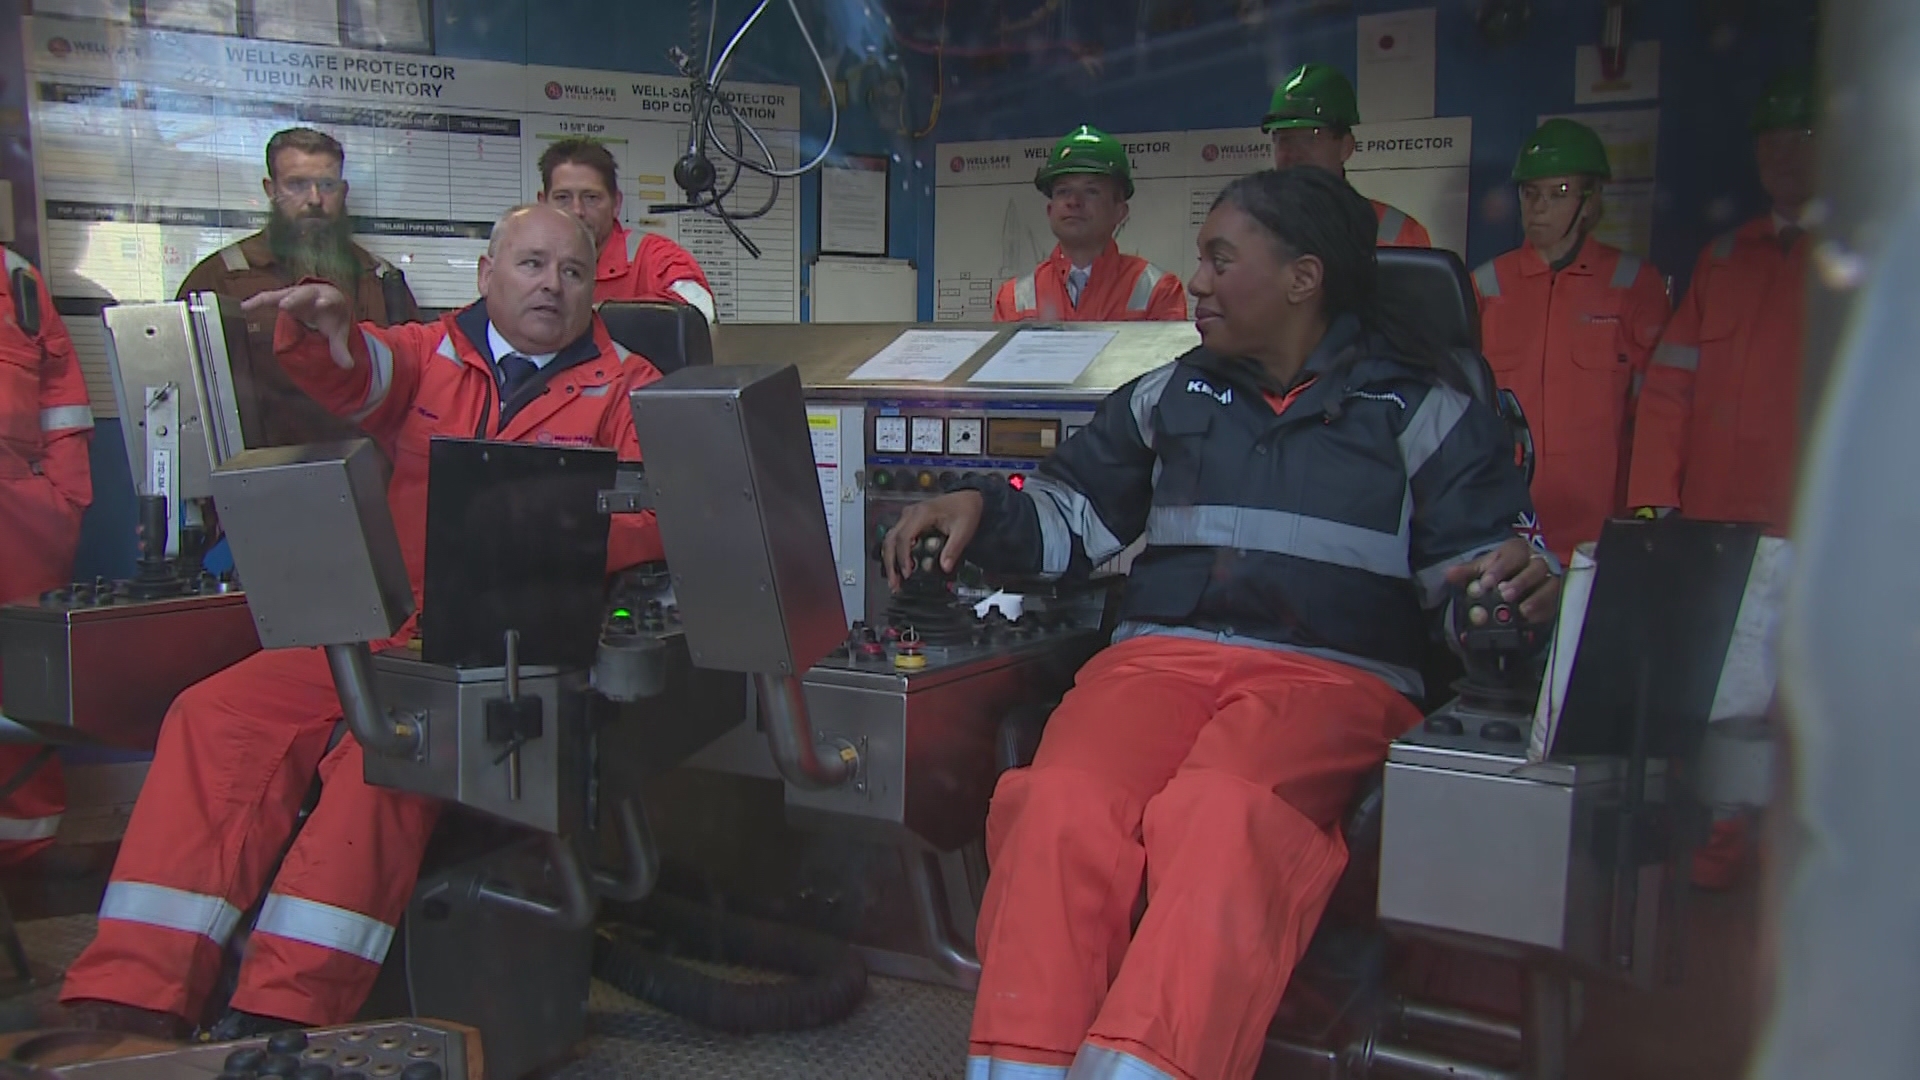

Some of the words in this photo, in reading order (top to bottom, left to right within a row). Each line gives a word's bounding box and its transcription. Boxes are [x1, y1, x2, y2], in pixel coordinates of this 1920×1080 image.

[226, 47, 338, 70] WELL-SAFE
[344, 59, 455, 80] PROTECTOR
[242, 67, 334, 90] TUBULAR
[340, 79, 443, 98] INVENTORY
[632, 84, 692, 99] WELL-SA
[721, 91, 785, 106] OTECTOR
[642, 100, 670, 112] BOP
[673, 102, 776, 120] COGUATION
[1120, 142, 1170, 154] TECTOR
[1355, 141, 1363, 152] E
[1367, 137, 1453, 151] PROTECTOR
[1132, 158, 1138, 169] L
